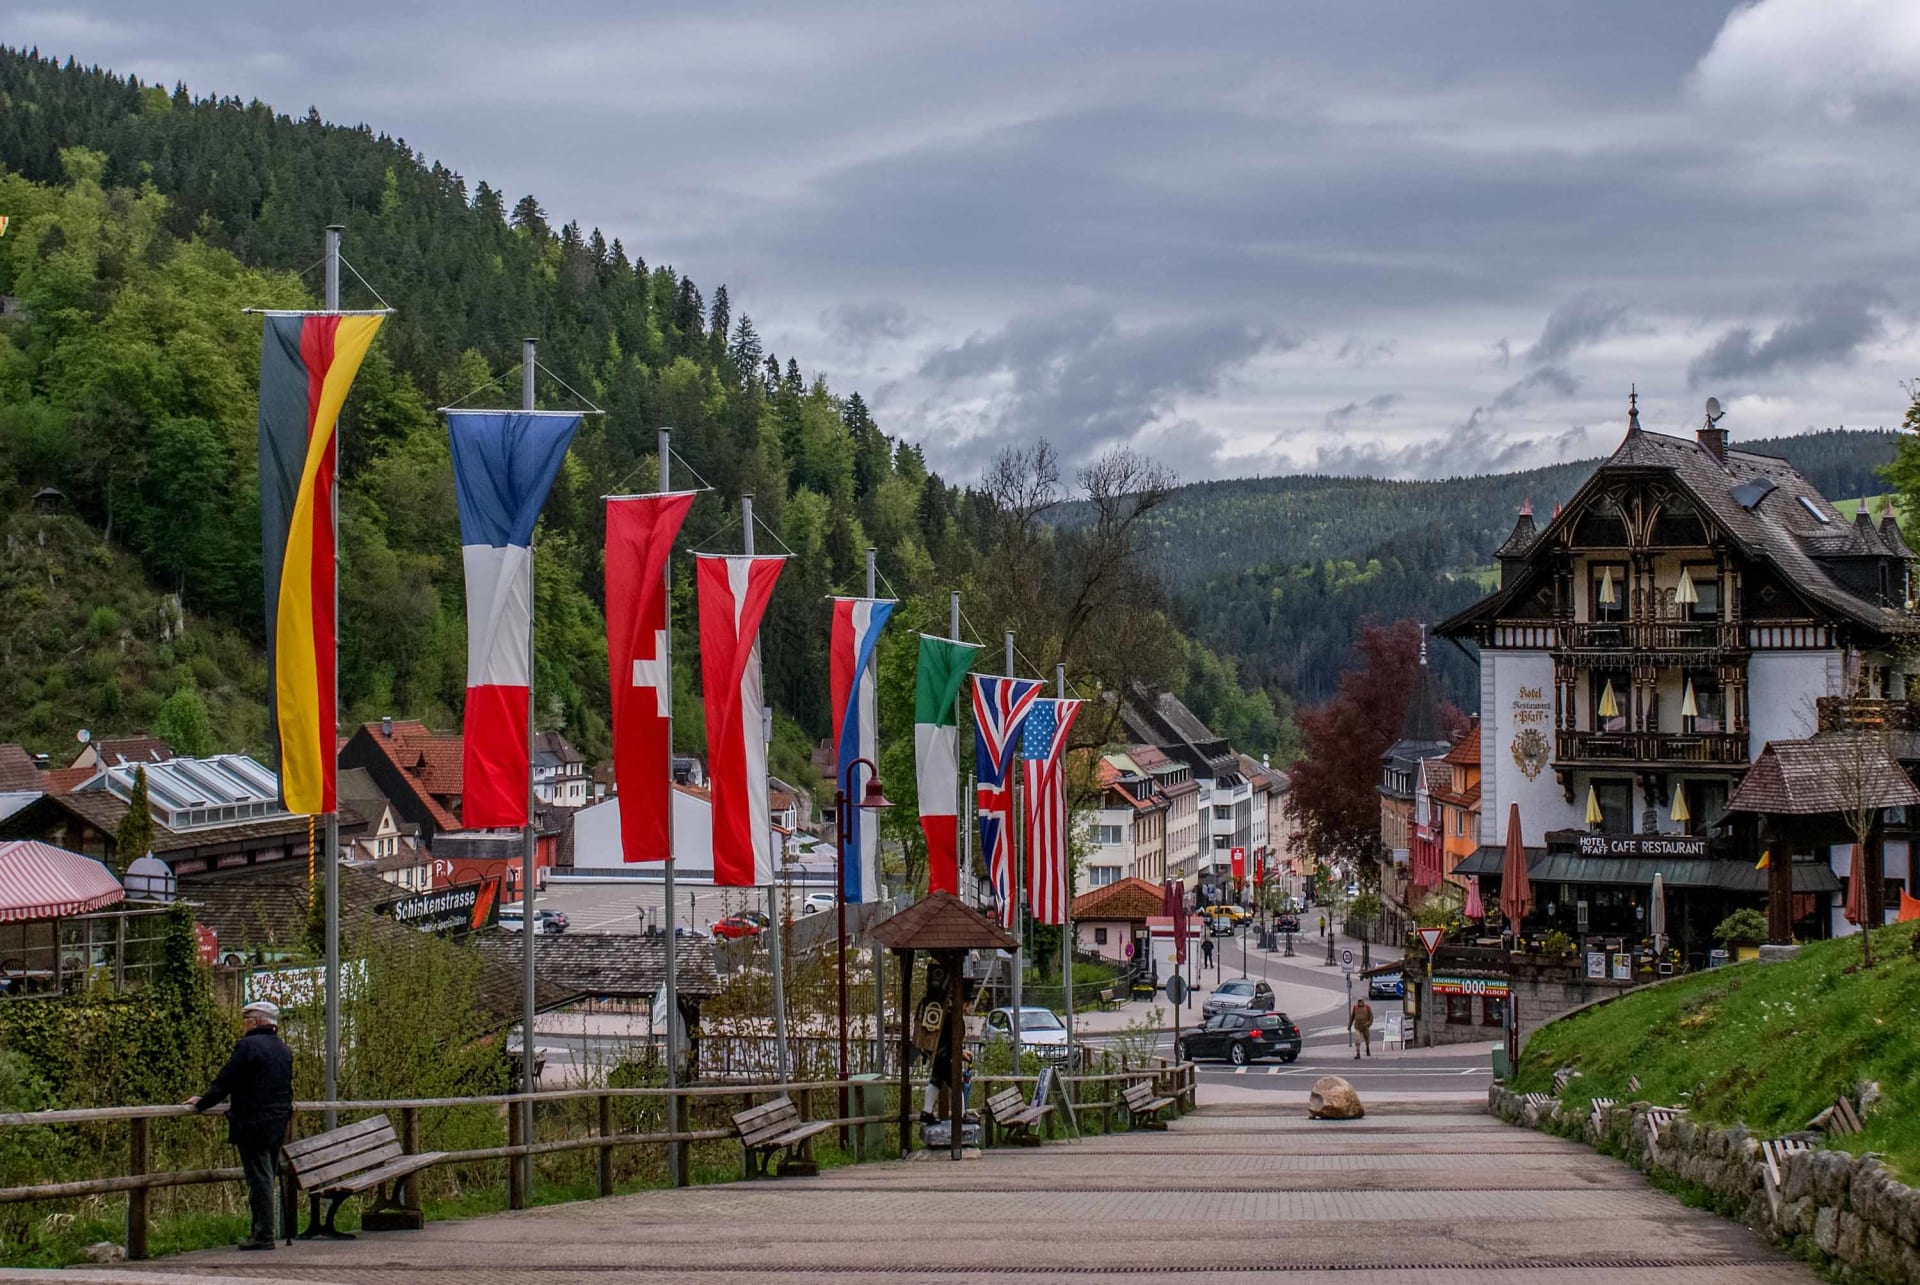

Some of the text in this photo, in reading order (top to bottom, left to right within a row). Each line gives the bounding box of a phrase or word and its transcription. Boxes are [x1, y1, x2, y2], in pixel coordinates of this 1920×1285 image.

[1580, 837, 1606, 847] HOTEL
[1611, 840, 1705, 855] CAFE RESTAURANT
[1582, 845, 1608, 855] PFAFF
[396, 890, 476, 921] Schinkenstrasse
[1461, 980, 1485, 994] 1000
